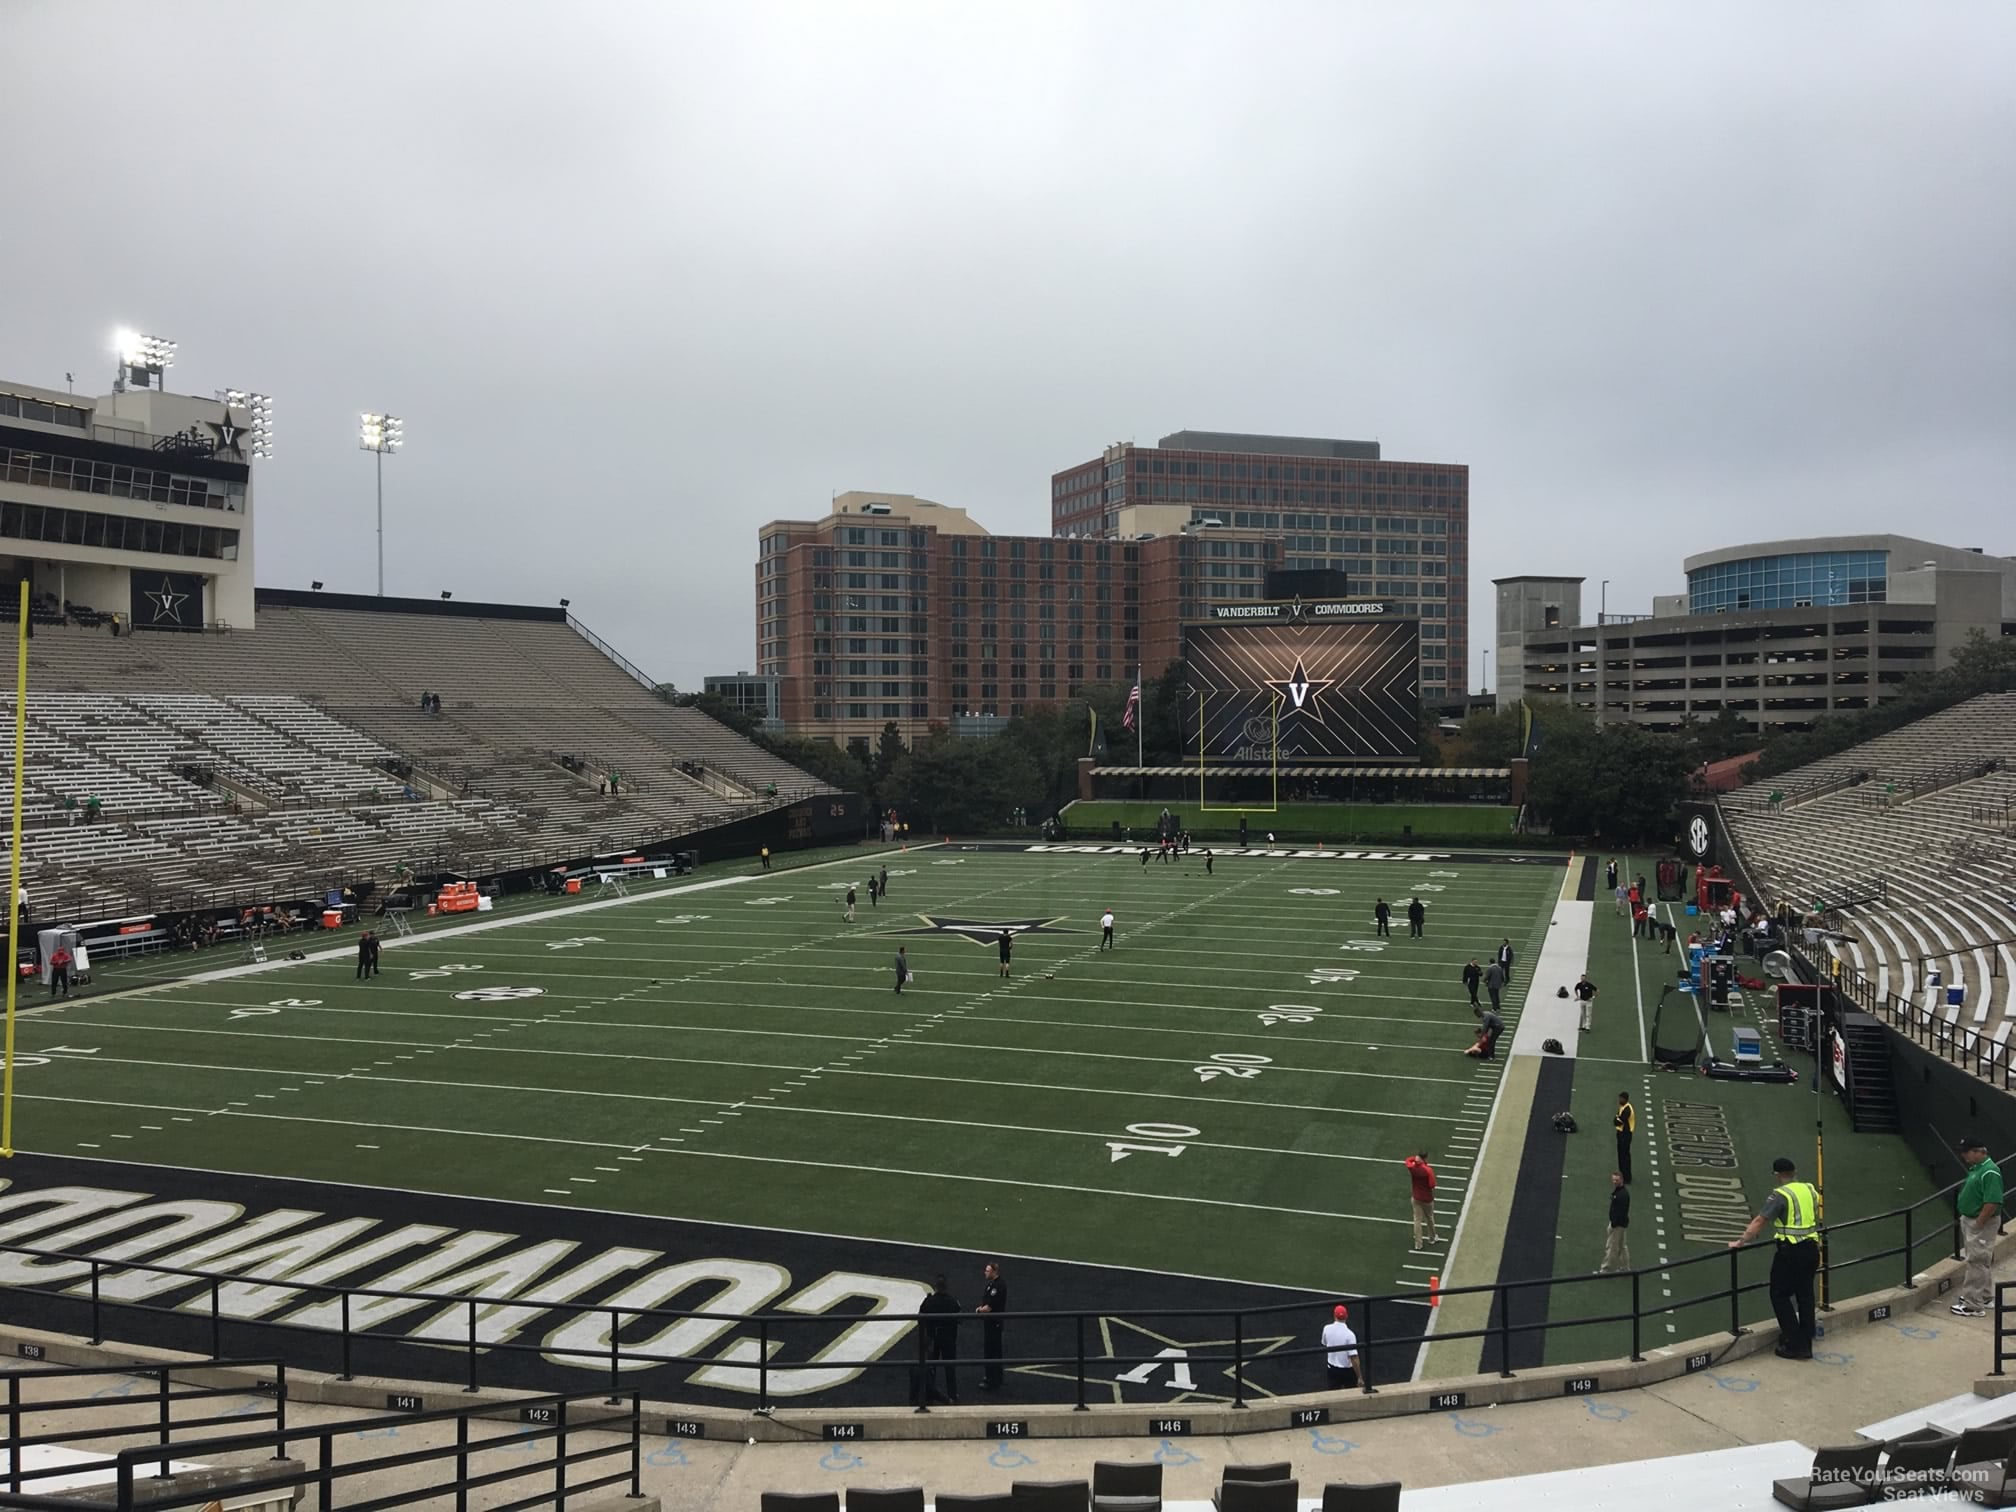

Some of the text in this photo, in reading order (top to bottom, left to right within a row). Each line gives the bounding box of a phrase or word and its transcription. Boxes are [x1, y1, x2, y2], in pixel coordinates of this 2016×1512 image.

[222, 426, 235, 445] V
[161, 595, 173, 609] V
[1217, 606, 1280, 617] VANDERBILT
[1314, 603, 1384, 615] COMMODORES
[1289, 683, 1309, 707] V
[1233, 747, 1290, 761] Allstate
[830, 804, 845, 817] 25
[1690, 817, 1708, 854] SEC
[1257, 1004, 1323, 1023] 30
[1193, 1053, 1273, 1079] 20
[1105, 1122, 1201, 1157] 10
[1663, 1099, 1738, 1168] ANCHOR
[1675, 1172, 1752, 1245] DOWN
[0, 1177, 934, 1396] COMMOD
[24, 1344, 39, 1357] 138
[1115, 1347, 1198, 1391] V
[1691, 1355, 1706, 1369] 150
[1571, 1379, 1592, 1392] 149
[396, 1397, 415, 1409] 141
[1438, 1395, 1459, 1407] 148
[528, 1409, 549, 1421] 142
[1300, 1411, 1321, 1424] 147
[676, 1422, 697, 1435] 143
[831, 1426, 855, 1438] 144
[995, 1423, 1019, 1435] 145
[1158, 1420, 1182, 1432] 146
